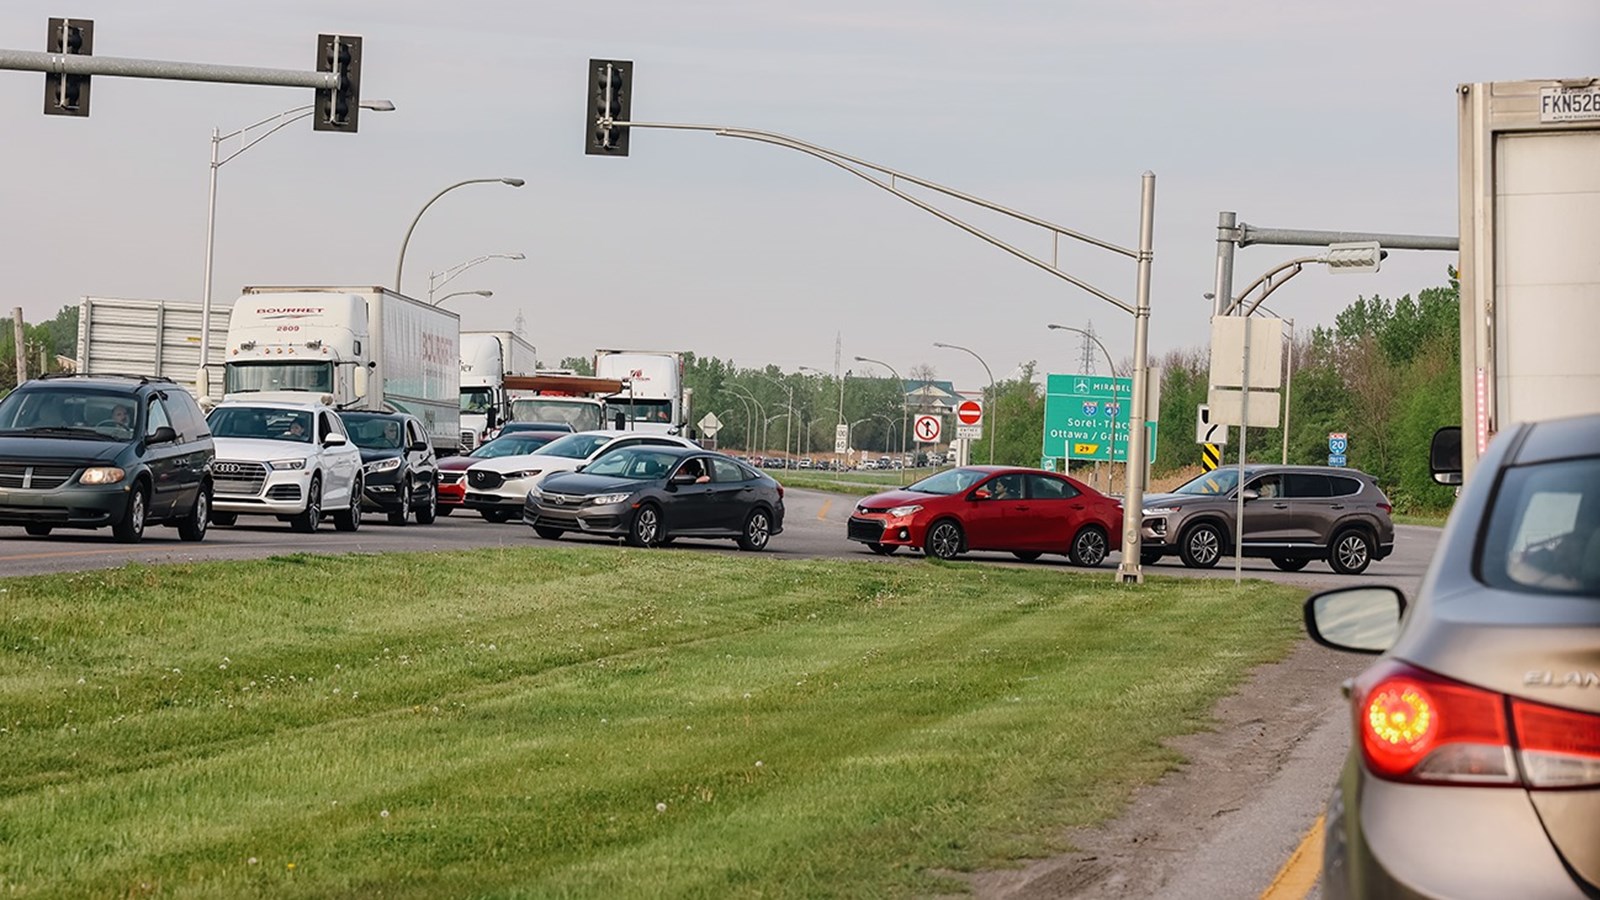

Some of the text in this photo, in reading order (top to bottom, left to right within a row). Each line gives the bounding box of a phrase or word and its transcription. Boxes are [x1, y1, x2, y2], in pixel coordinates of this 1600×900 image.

[1093, 383, 1131, 392] MIRABEL
[1050, 429, 1088, 439] Ottawa
[1100, 432, 1129, 441] Gatin
[1331, 440, 1344, 449] 20
